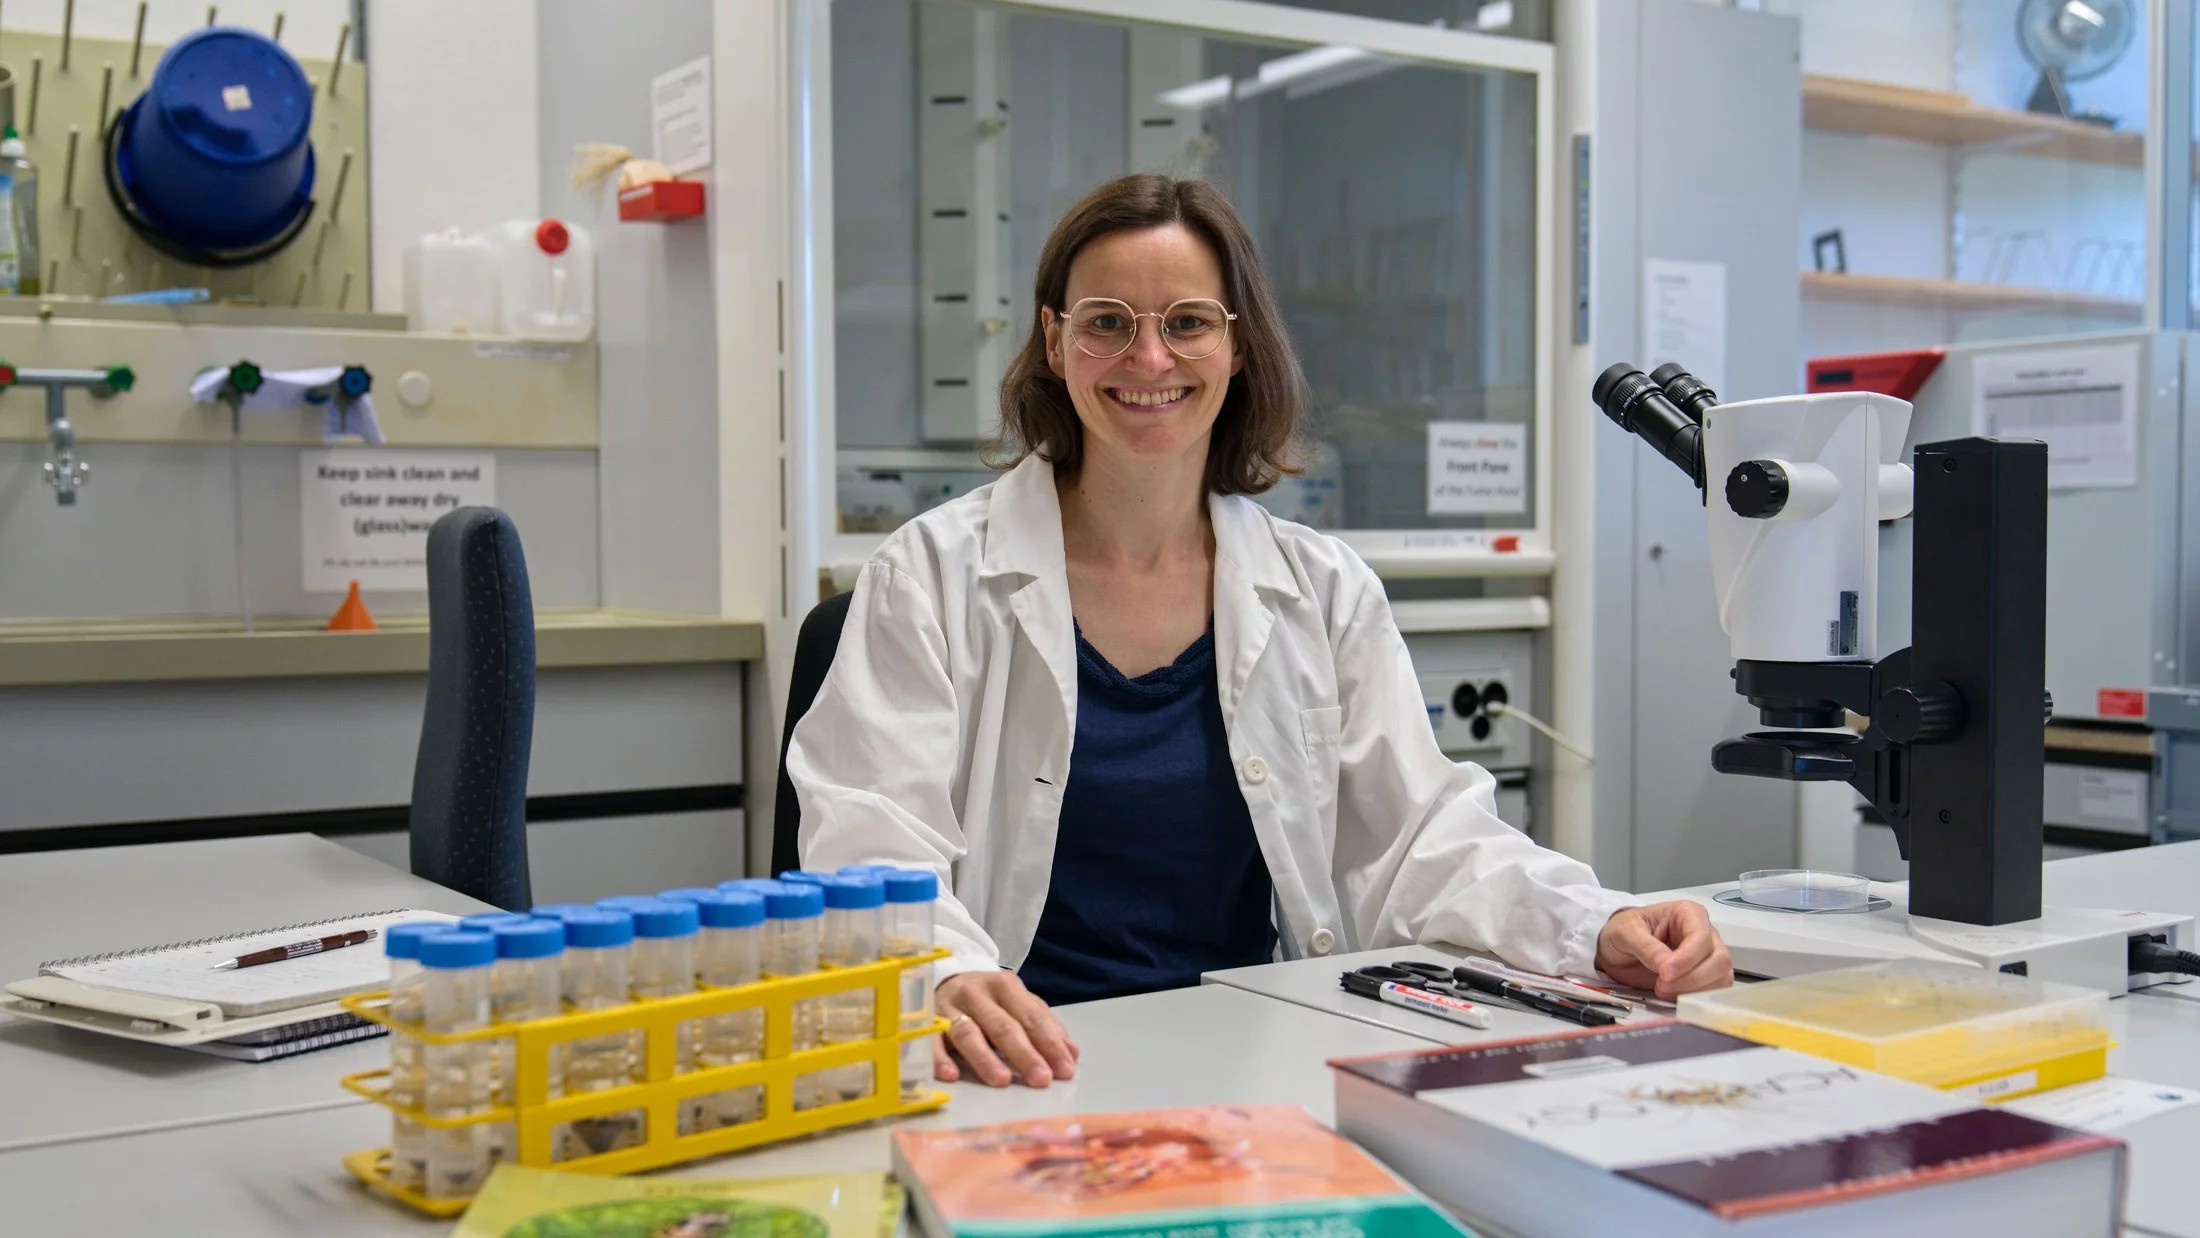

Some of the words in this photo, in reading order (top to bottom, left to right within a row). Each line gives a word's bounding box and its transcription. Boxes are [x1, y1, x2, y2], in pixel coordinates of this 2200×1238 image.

[317, 465, 360, 482] Keep
[365, 465, 397, 481] sink
[402, 465, 446, 481] clean
[450, 465, 480, 481] and
[1447, 460, 1477, 474] Front
[1482, 460, 1509, 474] Pane
[340, 491, 381, 507] clear
[386, 494, 429, 510] away
[433, 491, 460, 509] dry
[1405, 997, 1430, 1008] permanent
[1431, 1004, 1448, 1013] marker
